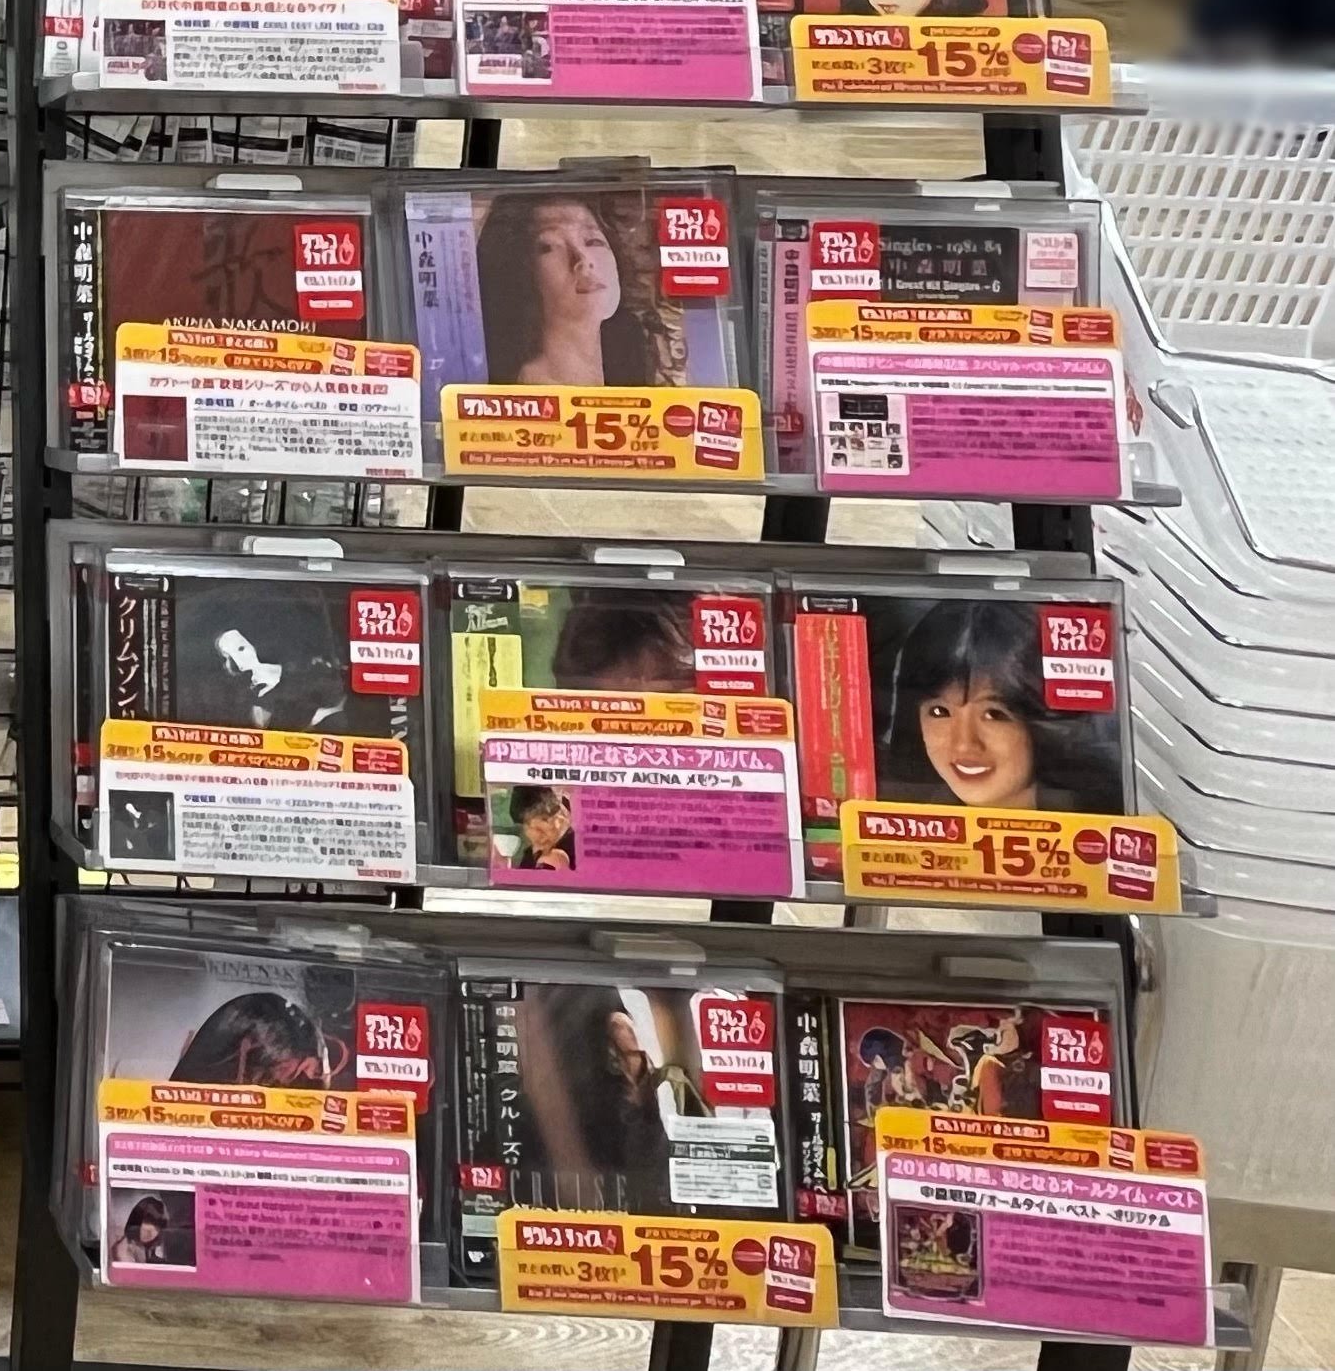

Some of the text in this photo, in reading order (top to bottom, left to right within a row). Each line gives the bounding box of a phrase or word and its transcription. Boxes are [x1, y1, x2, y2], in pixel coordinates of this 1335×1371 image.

[916, 41, 1010, 78] 15%
[565, 412, 660, 451] 15%
[972, 834, 1071, 878] 15%
[629, 1243, 728, 1288] 15%
